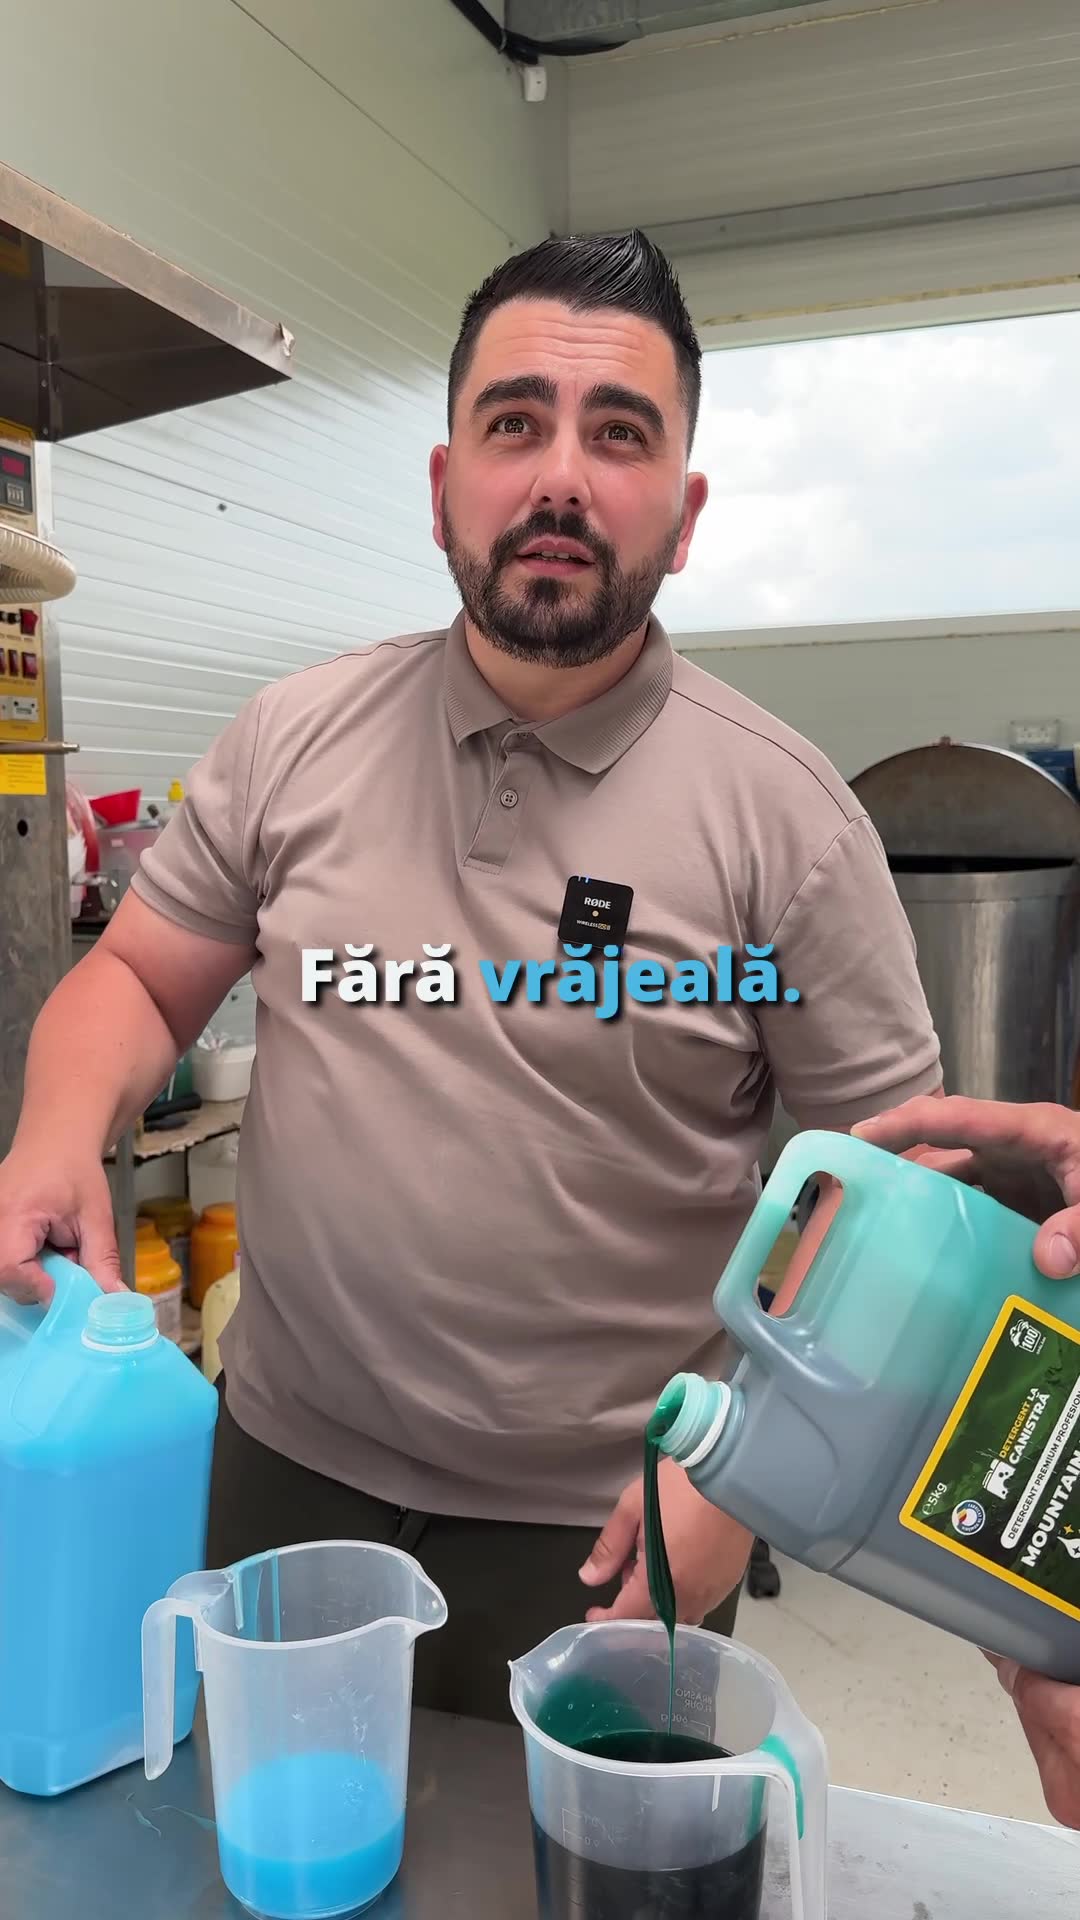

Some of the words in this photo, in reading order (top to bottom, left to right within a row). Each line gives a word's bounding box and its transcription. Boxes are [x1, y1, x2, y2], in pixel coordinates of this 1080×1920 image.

[584, 897, 611, 909] RØDE
[1022, 1329, 1039, 1349] 100
[999, 1401, 1031, 1459] DETERGENT
[1027, 1388, 1039, 1401] LA
[1008, 1392, 1050, 1465] CANISTRĂ
[1008, 1487, 1038, 1540] DETERGENT
[1034, 1443, 1060, 1486] PREMIUM
